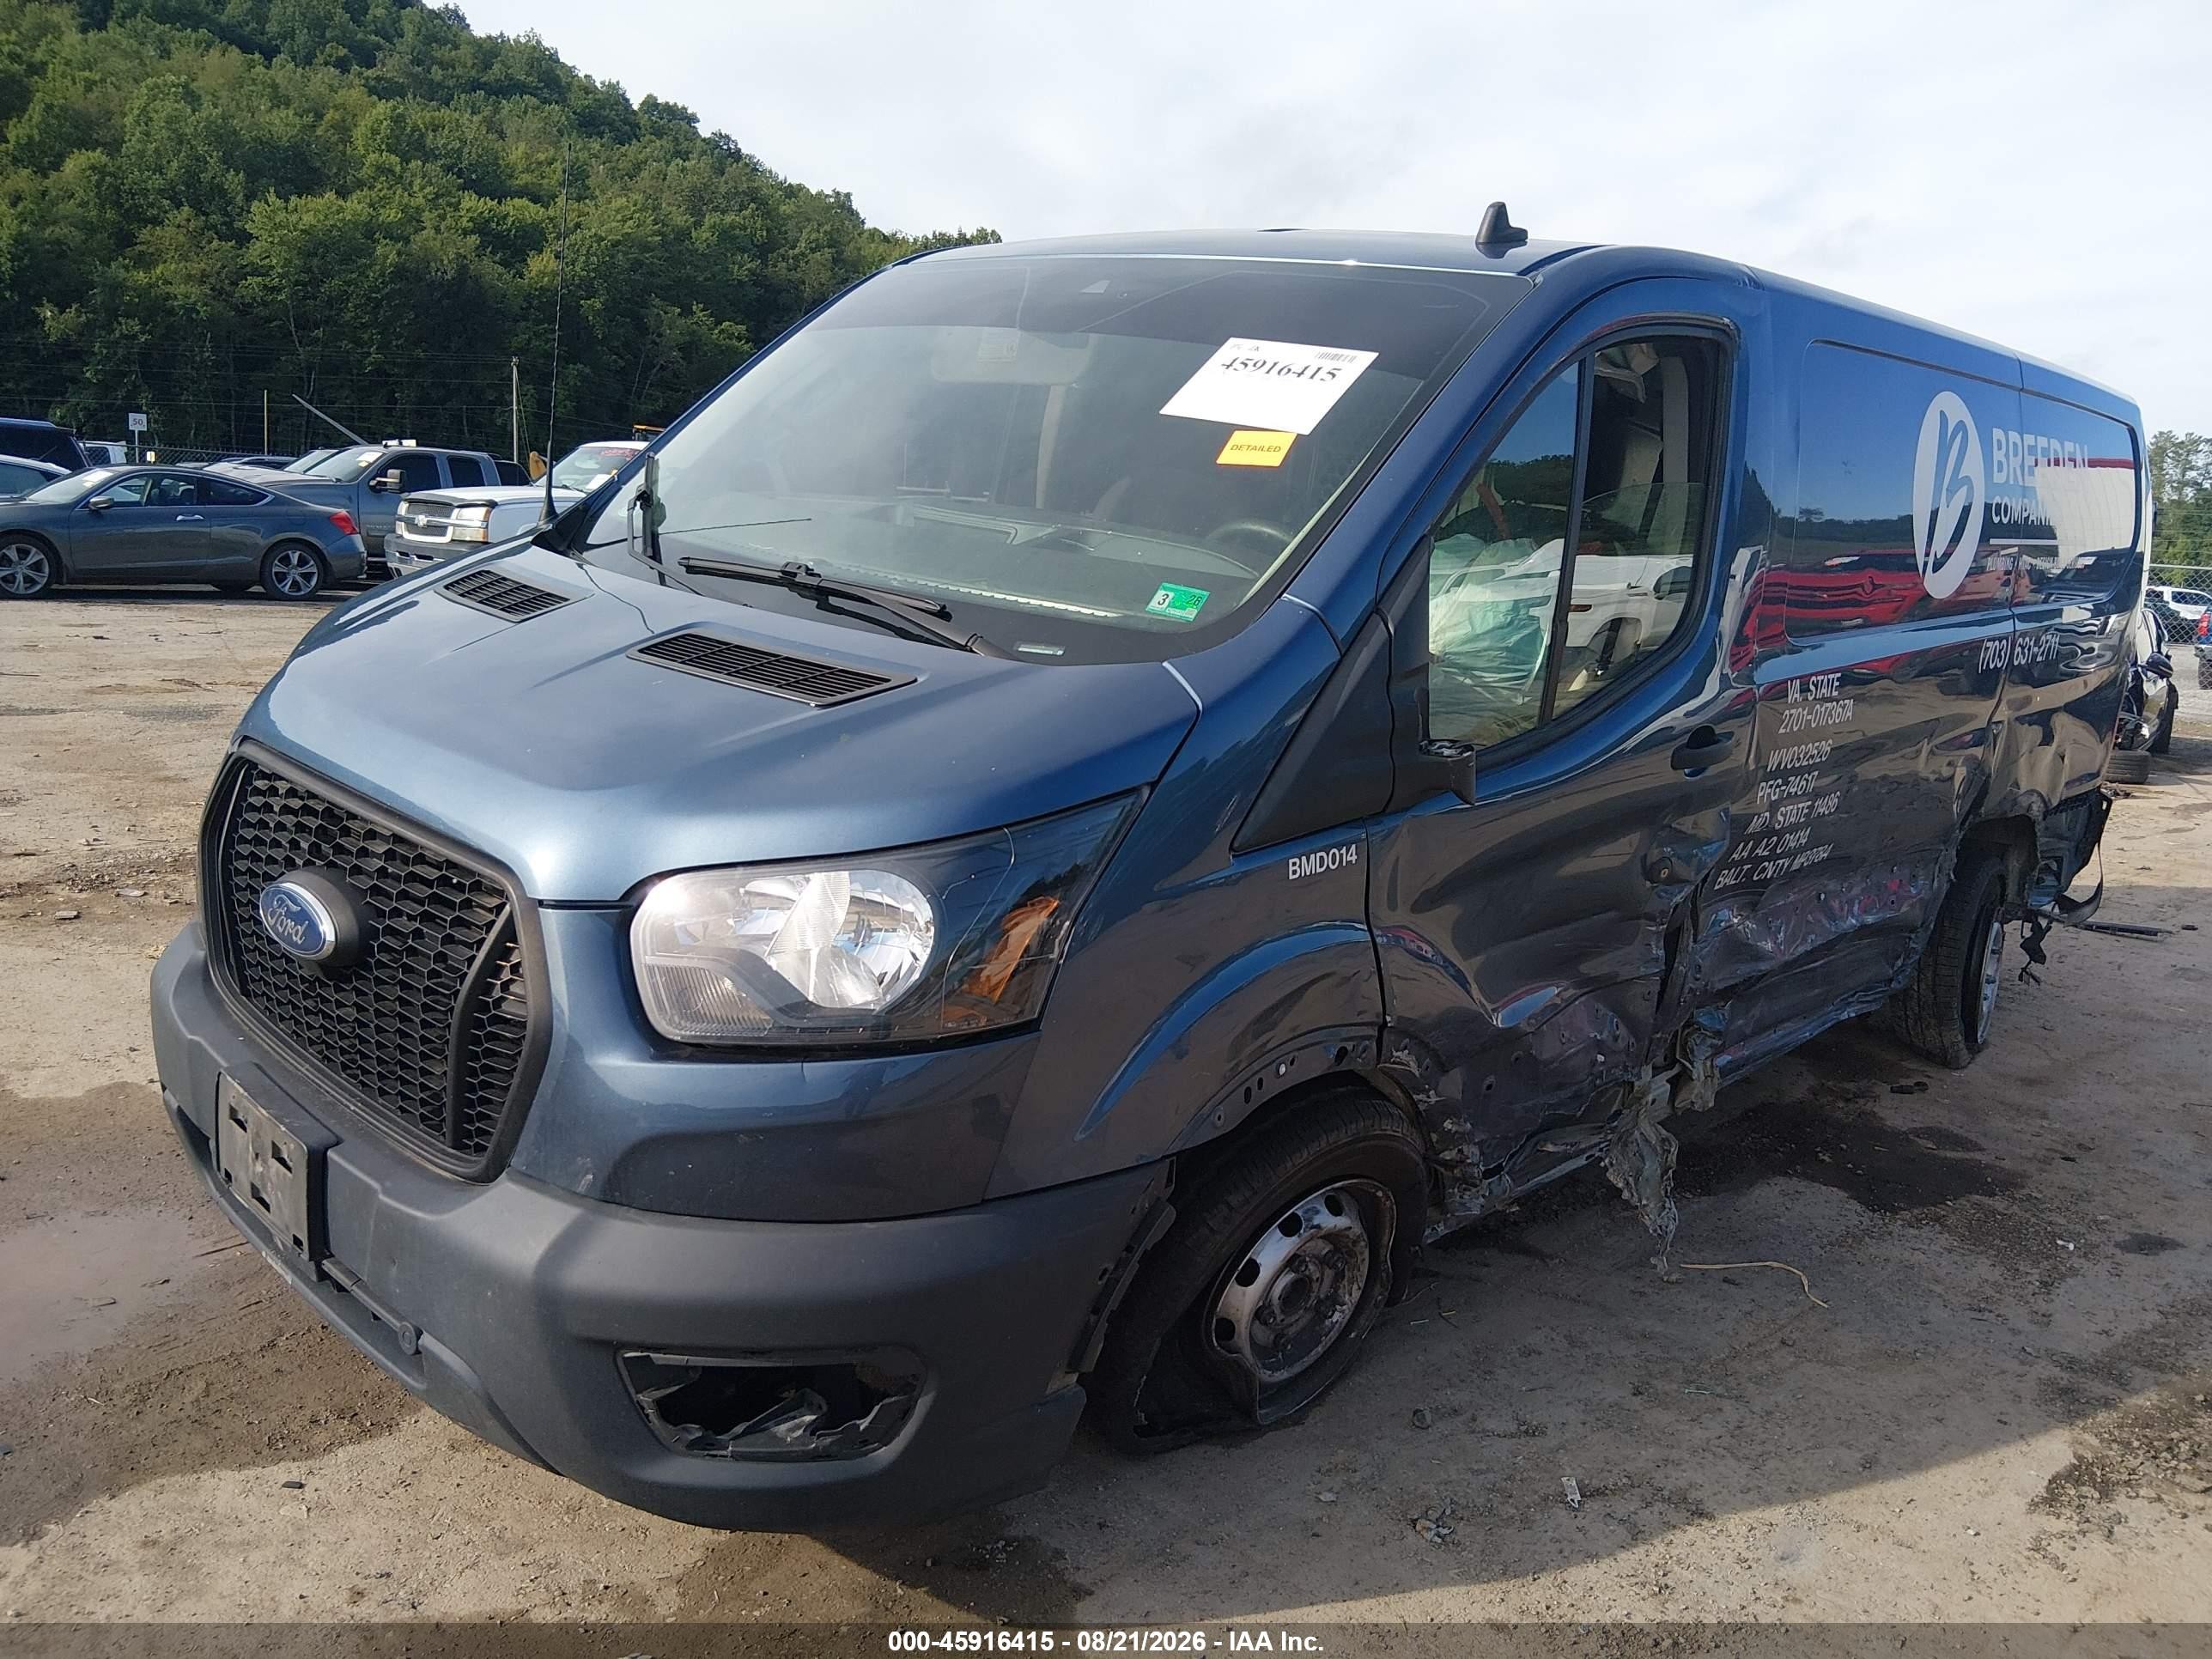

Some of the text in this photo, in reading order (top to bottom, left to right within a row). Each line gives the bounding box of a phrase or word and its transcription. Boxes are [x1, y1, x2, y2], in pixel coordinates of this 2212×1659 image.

[1221, 356, 1342, 382] 45916415
[1230, 443, 1282, 453] DETAILED
[1157, 592, 1170, 606] 3
[1978, 634, 2060, 674] (703) 631-2711
[1787, 672, 1841, 704] VA. STATE
[1778, 699, 1854, 734] 2701-017367A
[1766, 739, 1832, 772] WV032526
[1757, 770, 1819, 804] PFG-74617
[1774, 800, 1812, 830] STATE
[1810, 791, 1841, 818] 11486
[1728, 841, 1753, 862] AA
[1751, 836, 1778, 858] A2
[1713, 864, 1753, 890] BALT.
[1753, 856, 1794, 881] CNTY
[267, 894, 309, 945] Ford
